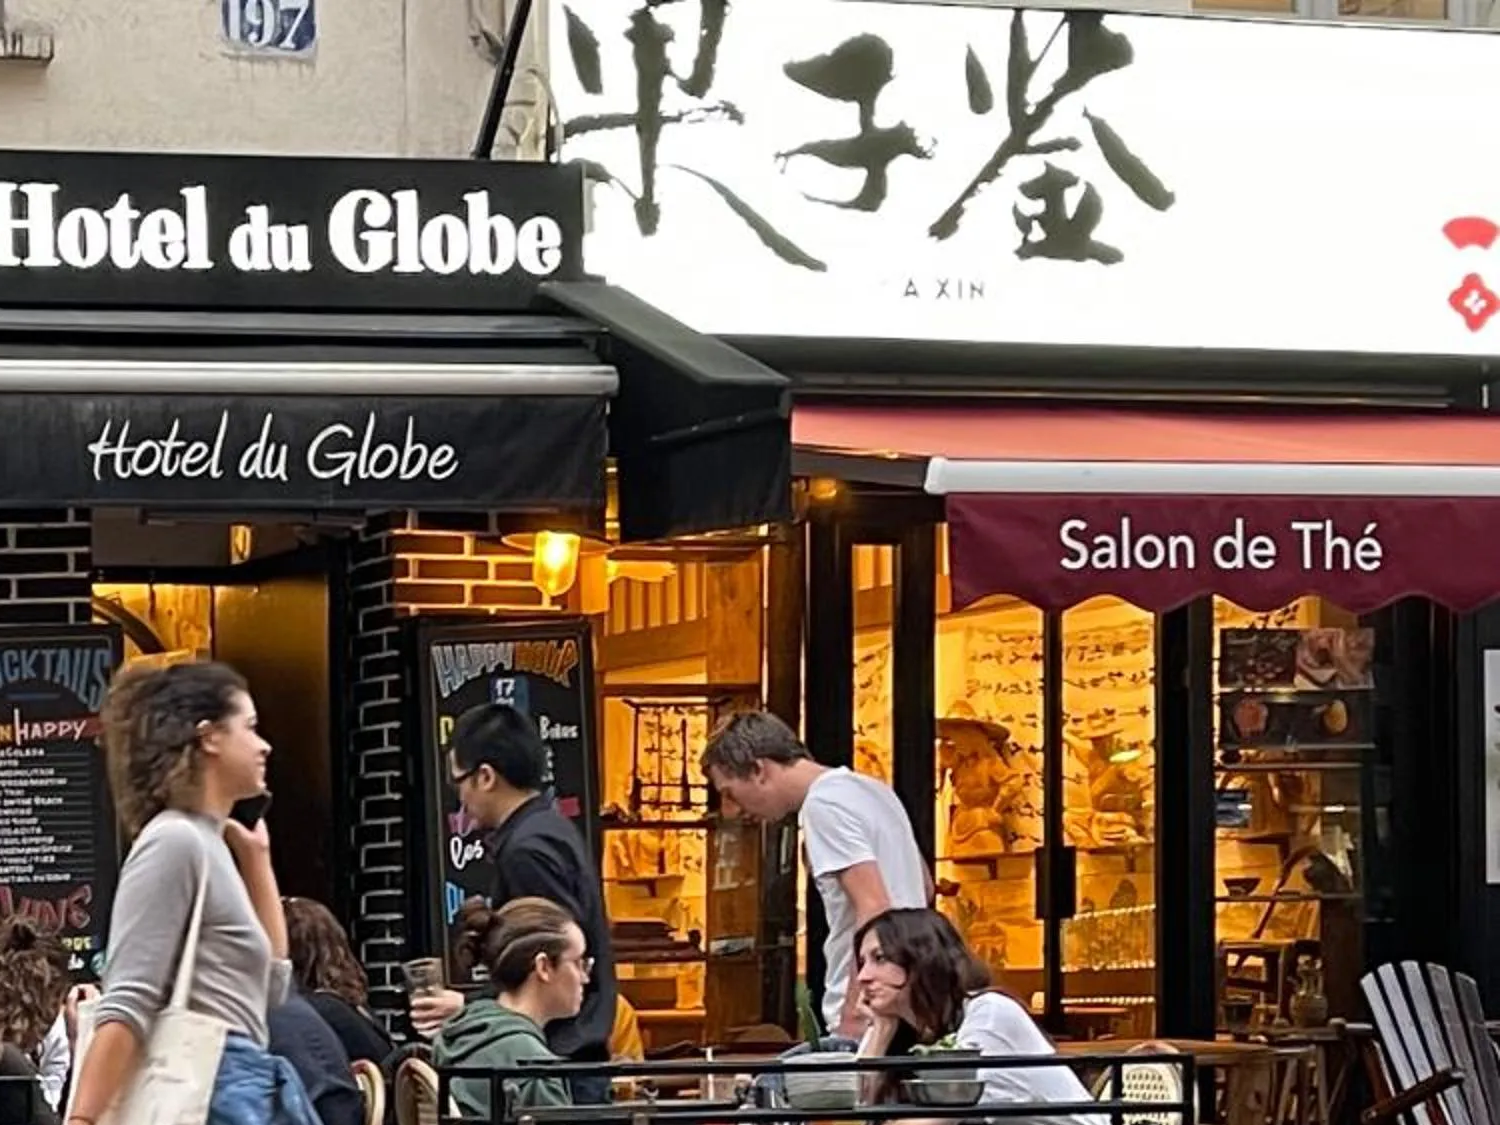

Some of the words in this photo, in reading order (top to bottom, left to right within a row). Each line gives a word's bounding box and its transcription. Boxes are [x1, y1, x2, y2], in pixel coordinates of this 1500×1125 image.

[227, 0, 309, 49] 197
[229, 204, 313, 272] du
[329, 188, 562, 275] Globe
[935, 277, 985, 299] XIN
[87, 409, 228, 480] Hotel
[239, 412, 288, 481] du
[307, 410, 459, 485] Globe
[1060, 516, 1196, 570] Salon
[1213, 517, 1277, 570] de
[1291, 519, 1384, 571] Thé
[431, 640, 514, 699] HAPPY
[13, 708, 87, 745] HAPPY
